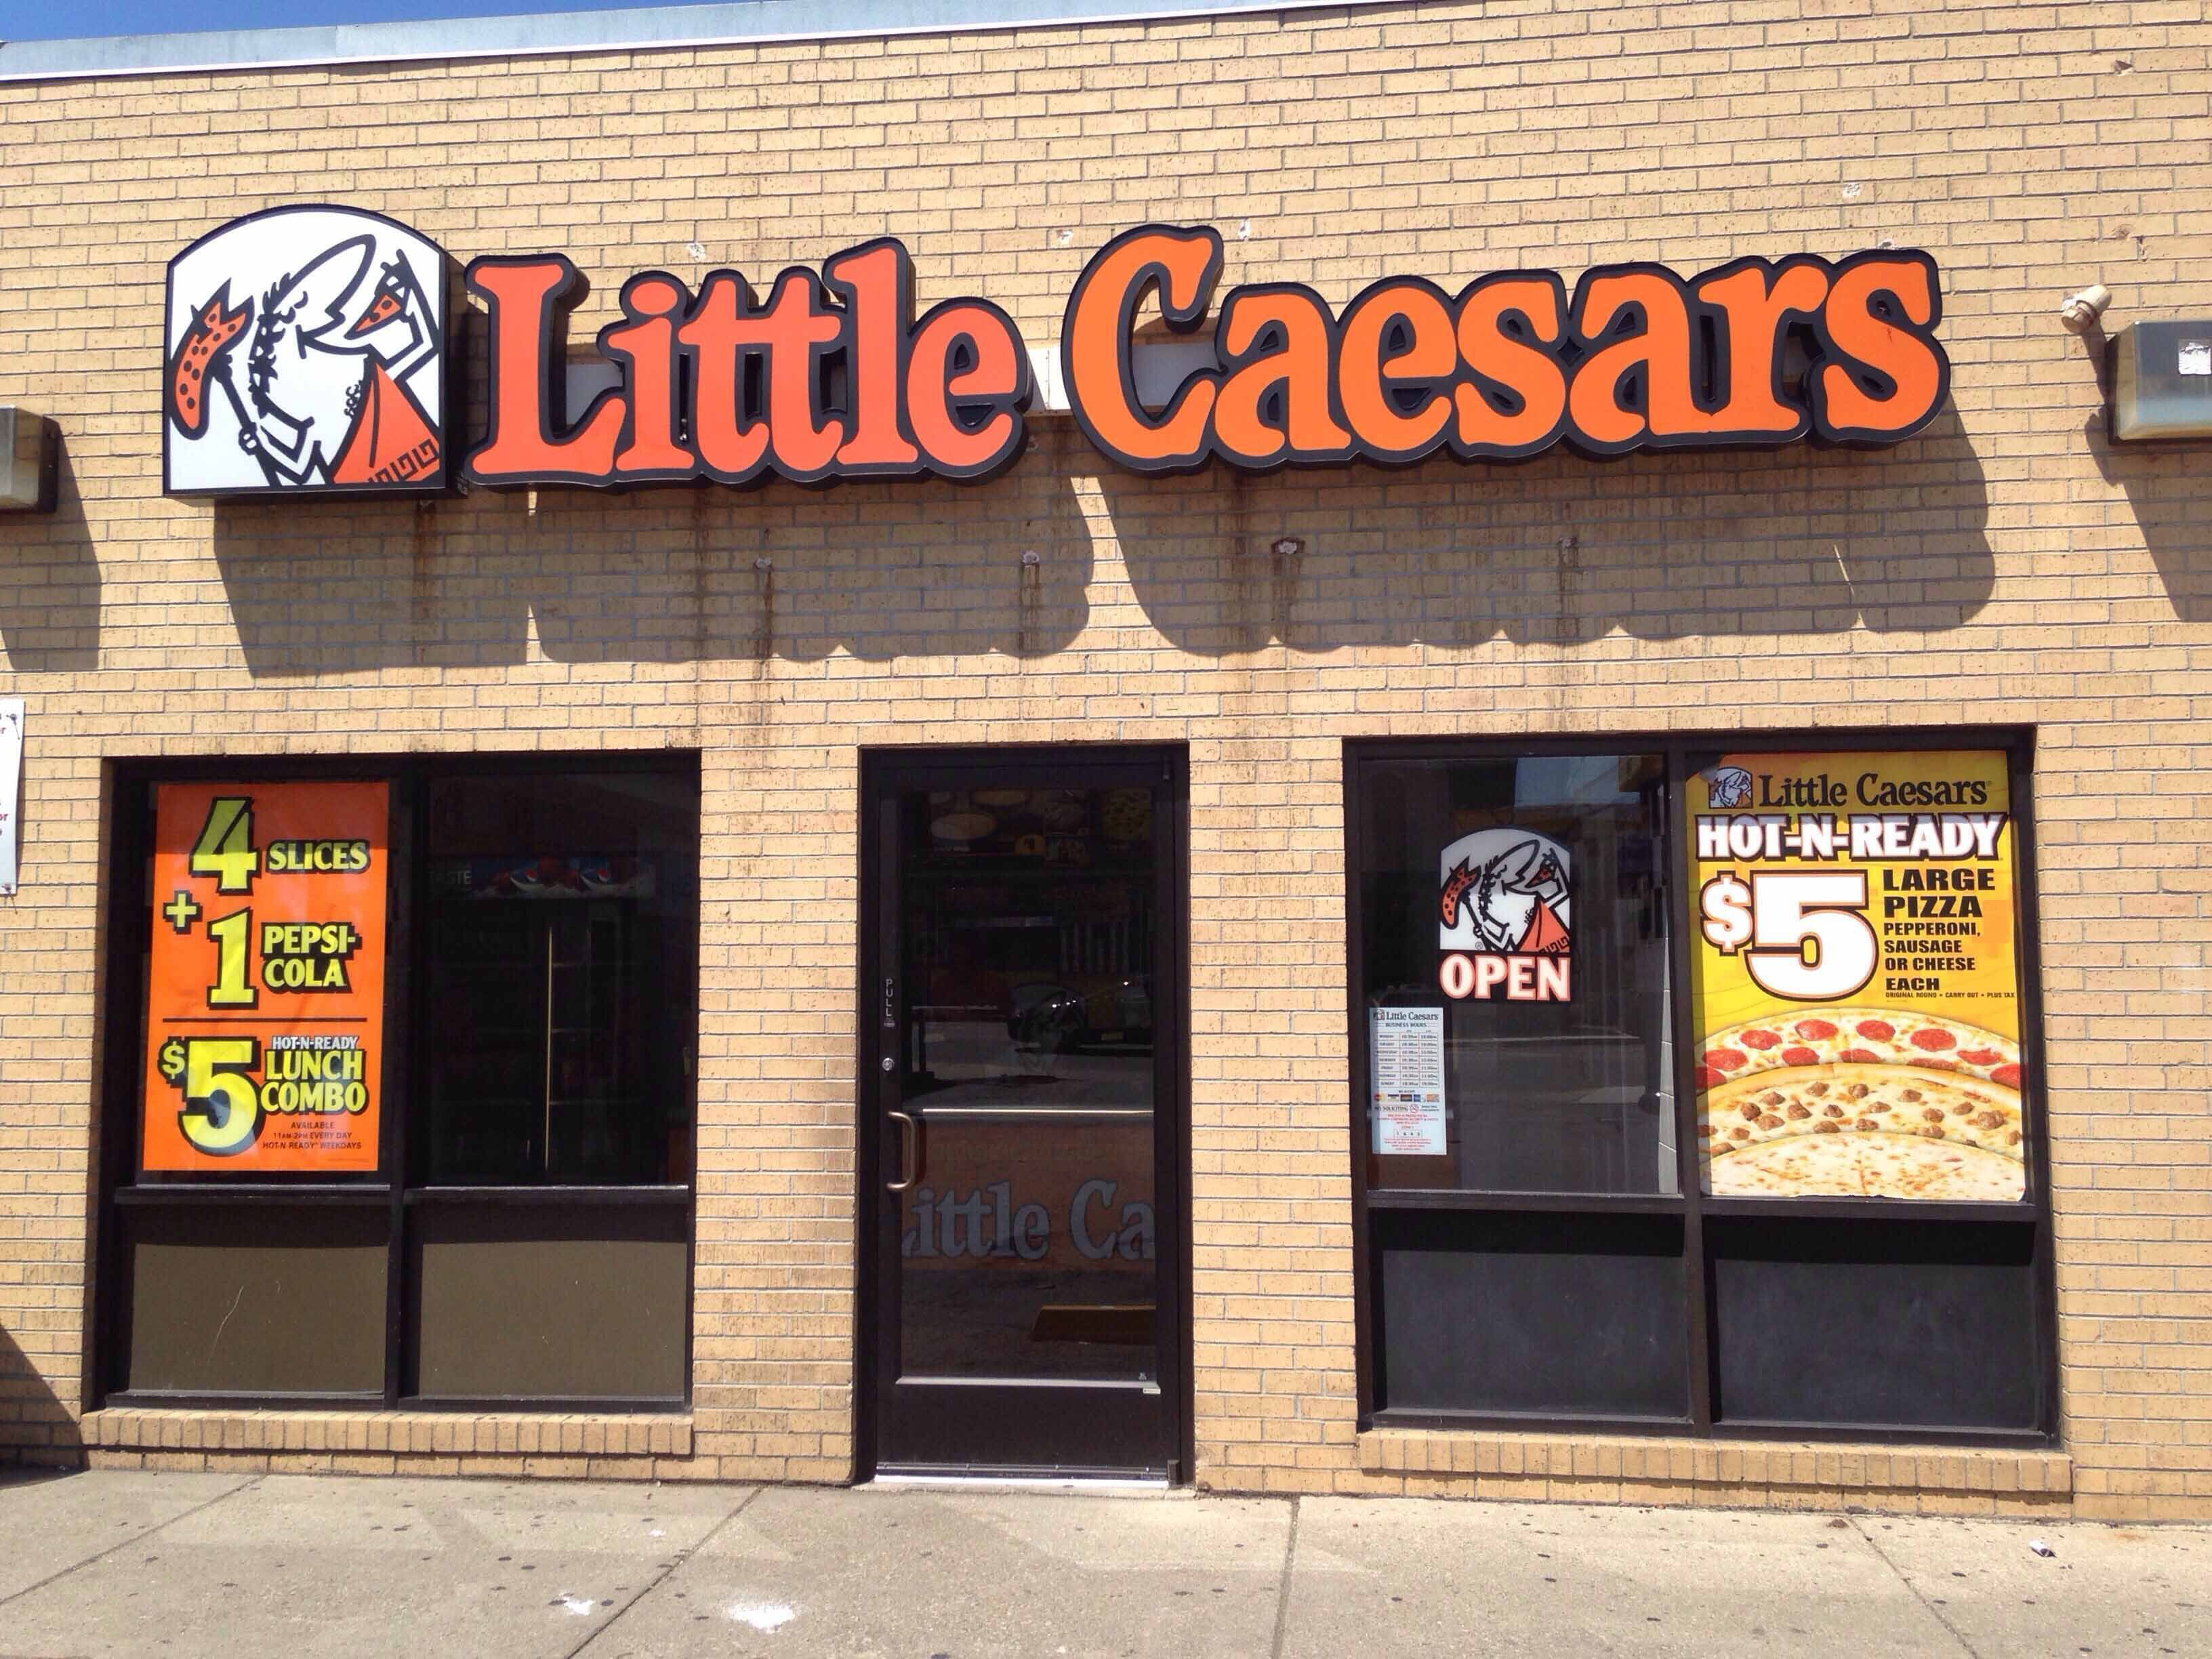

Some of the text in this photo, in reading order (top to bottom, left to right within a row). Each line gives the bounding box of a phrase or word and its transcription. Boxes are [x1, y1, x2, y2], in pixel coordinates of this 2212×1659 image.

[466, 224, 1950, 483] Little Caesars
[1758, 773, 1988, 808] Little Caesars
[191, 797, 368, 890] 4 SLICES
[1697, 814, 2006, 859] HOT-N-READY
[1883, 869, 1995, 890] LARGE
[1884, 895, 1983, 918] PIZZA
[1702, 871, 1878, 1001] $5
[1884, 922, 1981, 937] PEPPERONI,
[211, 911, 255, 1003] 1
[1885, 939, 1962, 954] SAUSAGE
[263, 958, 345, 987] COLA
[1439, 954, 1571, 1002] OPEN
[1885, 957, 1975, 971] OR CHEESE
[885, 978, 894, 1017] PULL
[1885, 977, 1940, 991] EACH
[1386, 1011, 1439, 1021] Little Caesars
[272, 1036, 359, 1050] HOT-N-READY
[266, 1050, 363, 1080] LUNCH
[260, 1082, 367, 1112] COMBO
[320, 1141, 362, 1149] WEEKDAYS
